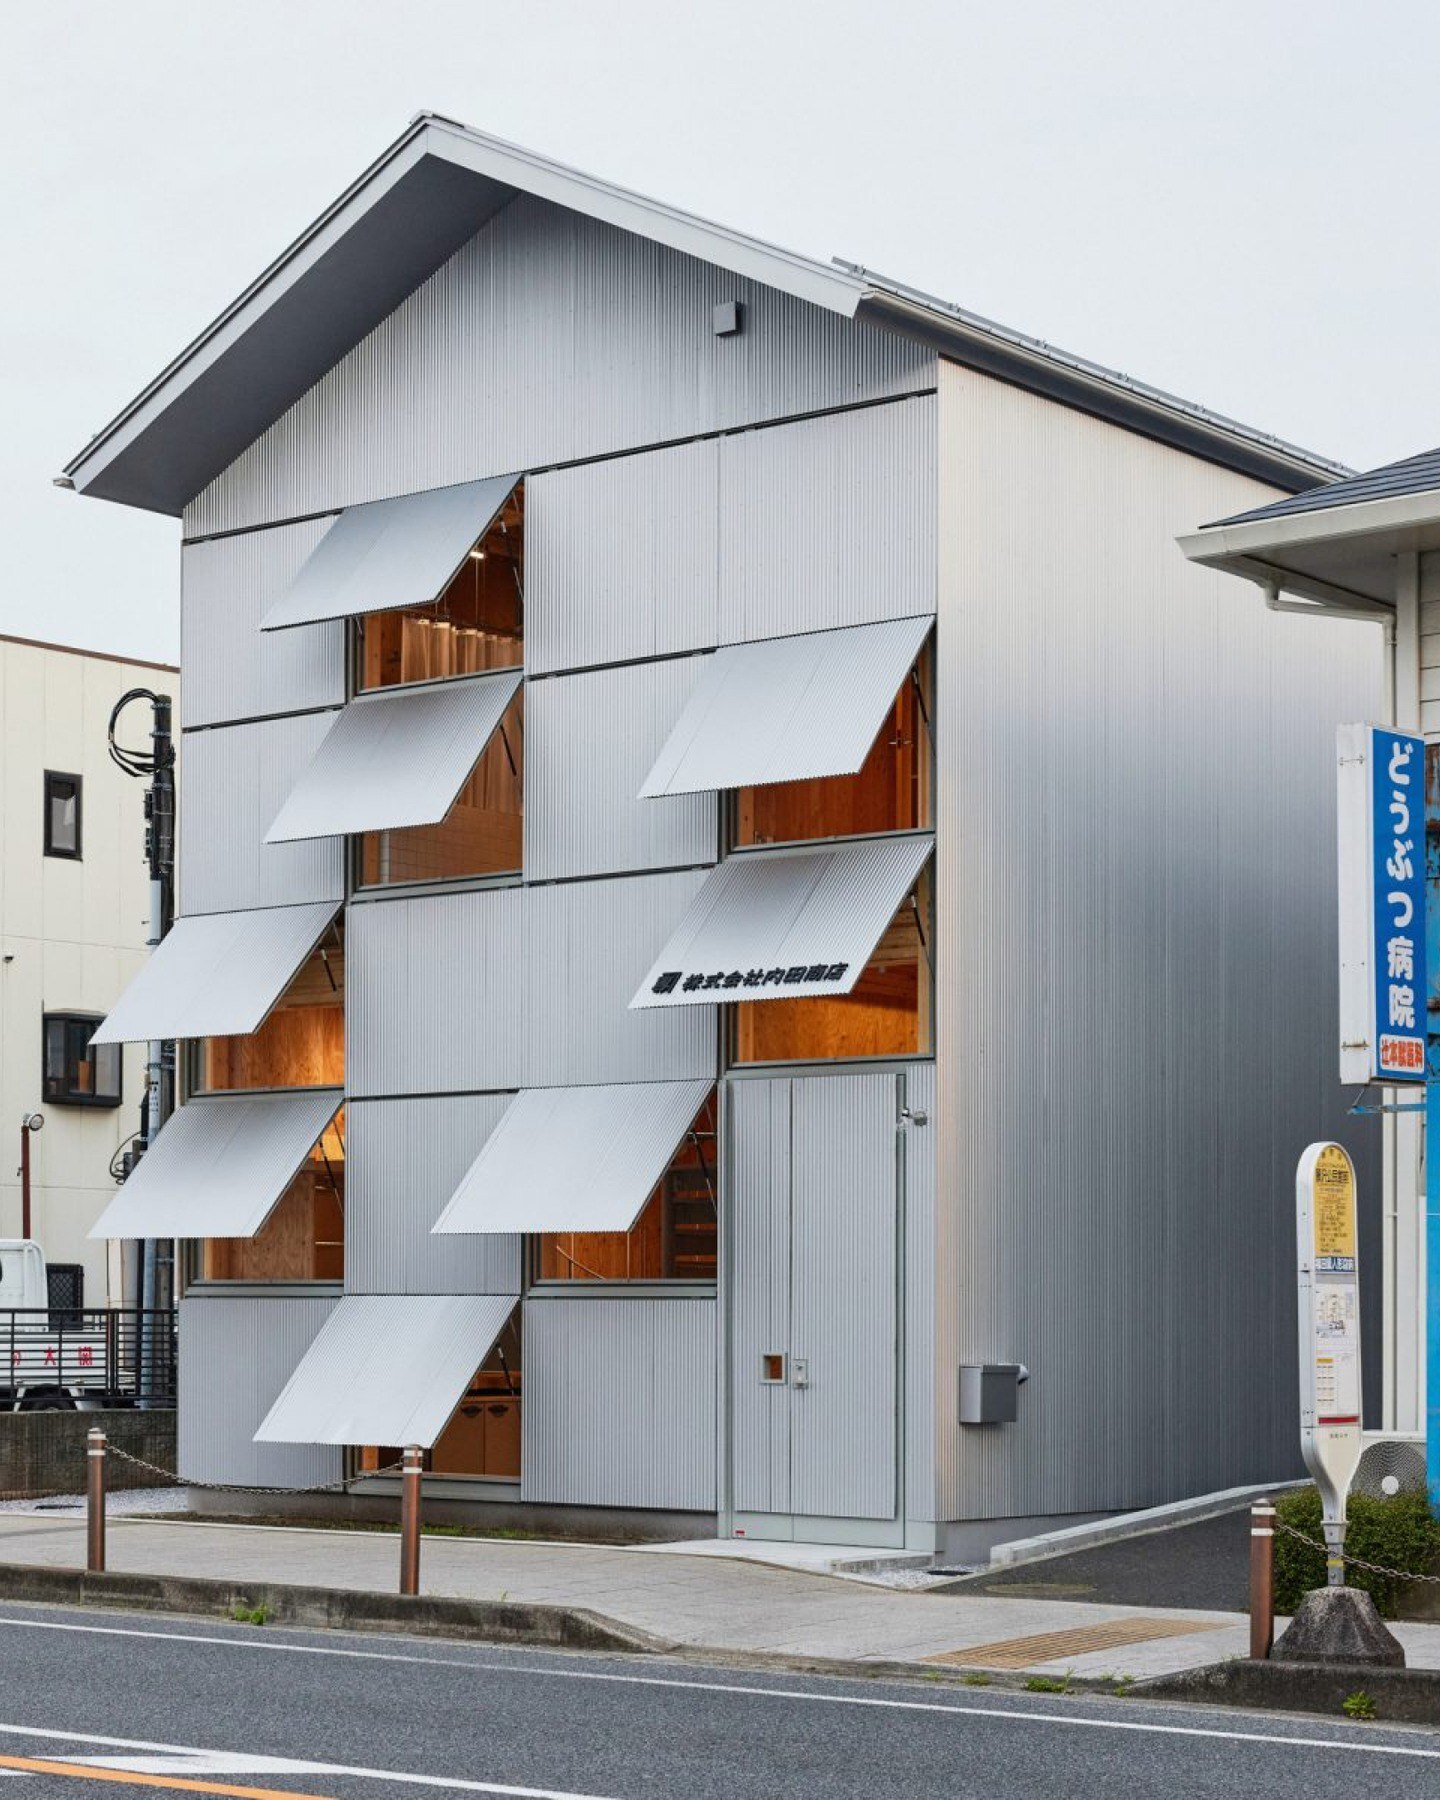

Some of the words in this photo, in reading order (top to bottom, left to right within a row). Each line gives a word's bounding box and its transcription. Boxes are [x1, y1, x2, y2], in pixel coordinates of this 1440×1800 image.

[1386, 741, 1415, 1029] どうぶつ病院
[683, 962, 849, 992] 株式会社内田商店
